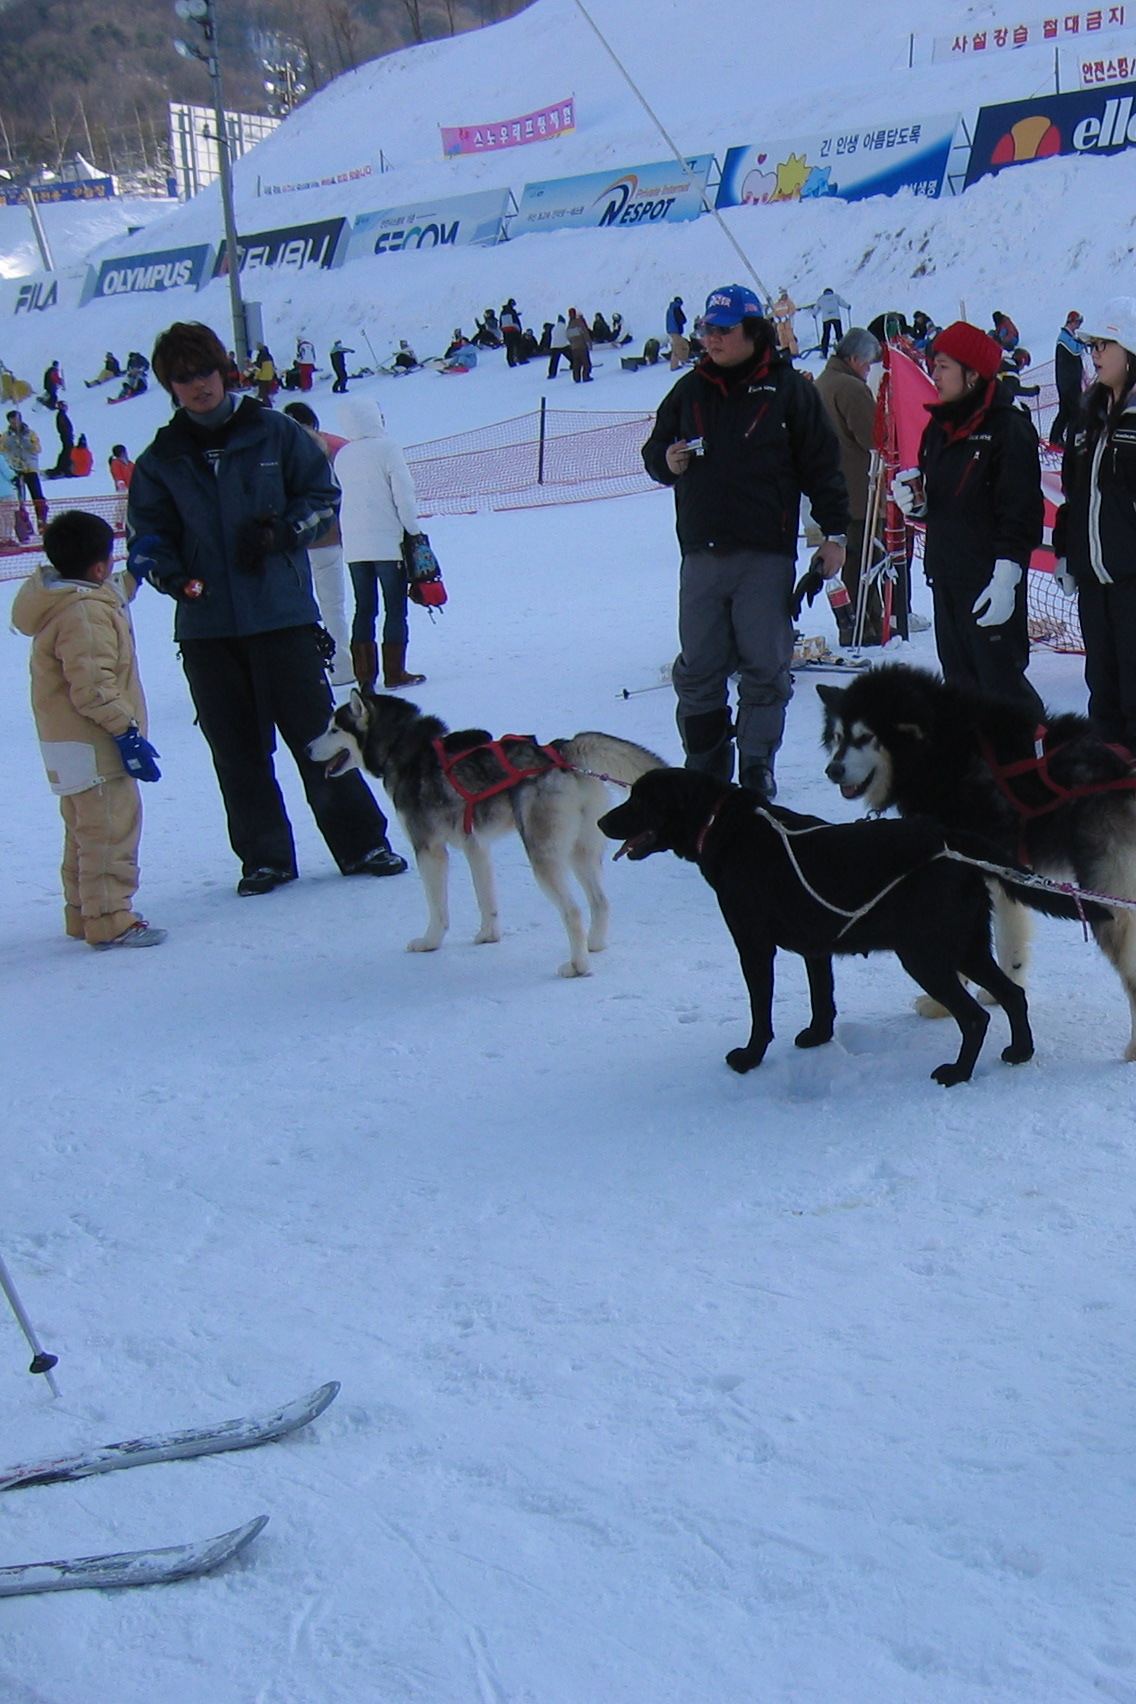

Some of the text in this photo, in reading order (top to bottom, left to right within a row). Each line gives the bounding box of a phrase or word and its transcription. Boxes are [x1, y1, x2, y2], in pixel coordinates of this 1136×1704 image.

[952, 6, 1125, 53] 사설강습 절대금지
[820, 124, 921, 157] 긴 인생 아름답도록
[598, 198, 676, 228] NESPOT
[103, 259, 193, 295] OLYMPUS
[14, 280, 58, 315] FILA
